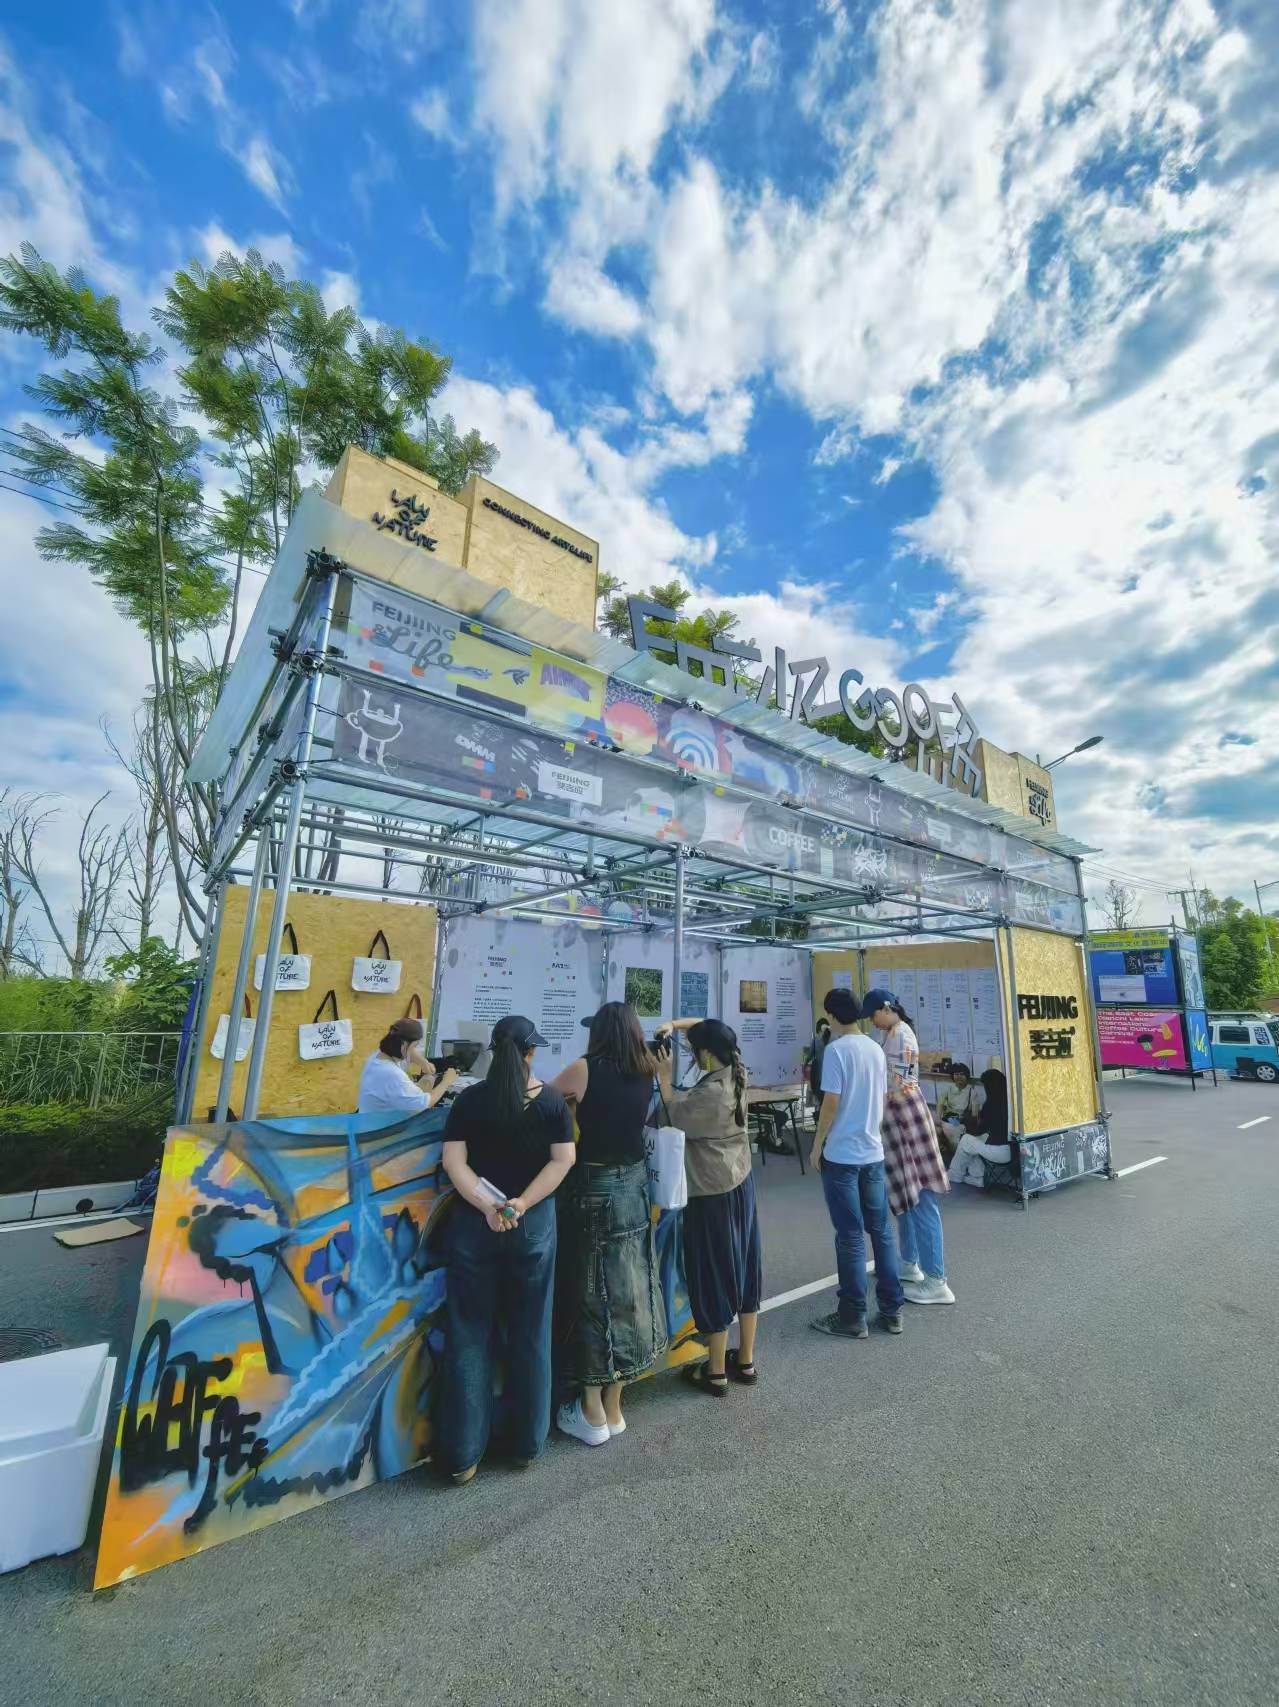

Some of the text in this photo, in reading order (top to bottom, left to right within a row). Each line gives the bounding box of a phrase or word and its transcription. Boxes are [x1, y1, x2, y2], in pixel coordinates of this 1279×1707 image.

[483, 498, 551, 540] CONNECTING
[768, 826, 816, 853] COFFEE
[311, 1039, 341, 1050] NATURE
